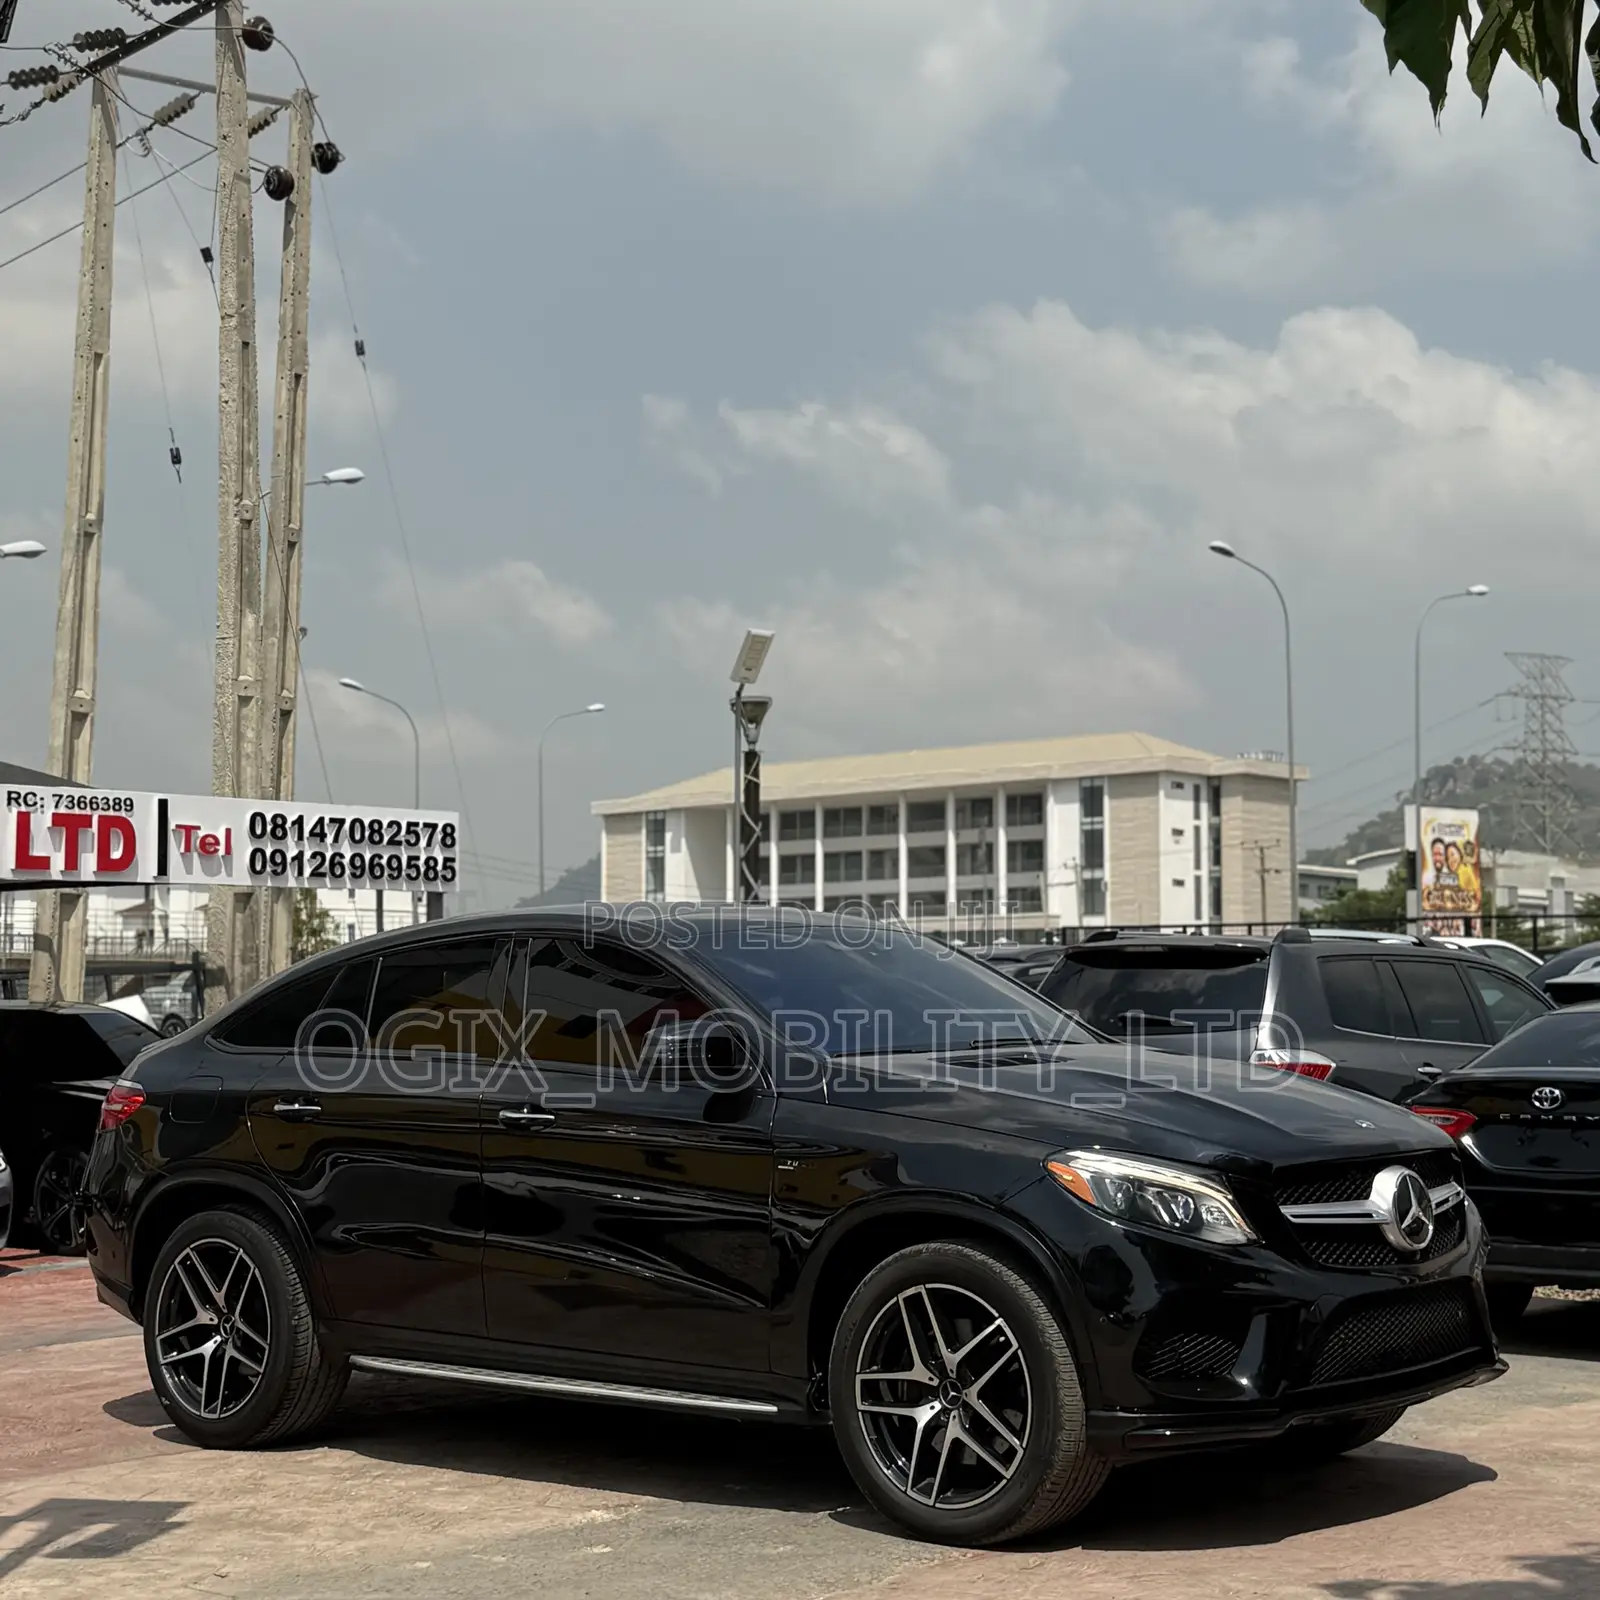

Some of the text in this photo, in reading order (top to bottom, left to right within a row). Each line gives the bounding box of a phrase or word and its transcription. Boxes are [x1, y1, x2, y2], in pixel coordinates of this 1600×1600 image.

[7, 790, 134, 812] RC: 7366389
[12, 811, 137, 873] LTD
[175, 824, 232, 856] Tel
[250, 812, 456, 848] 08147082578
[250, 847, 456, 882] 09126969585
